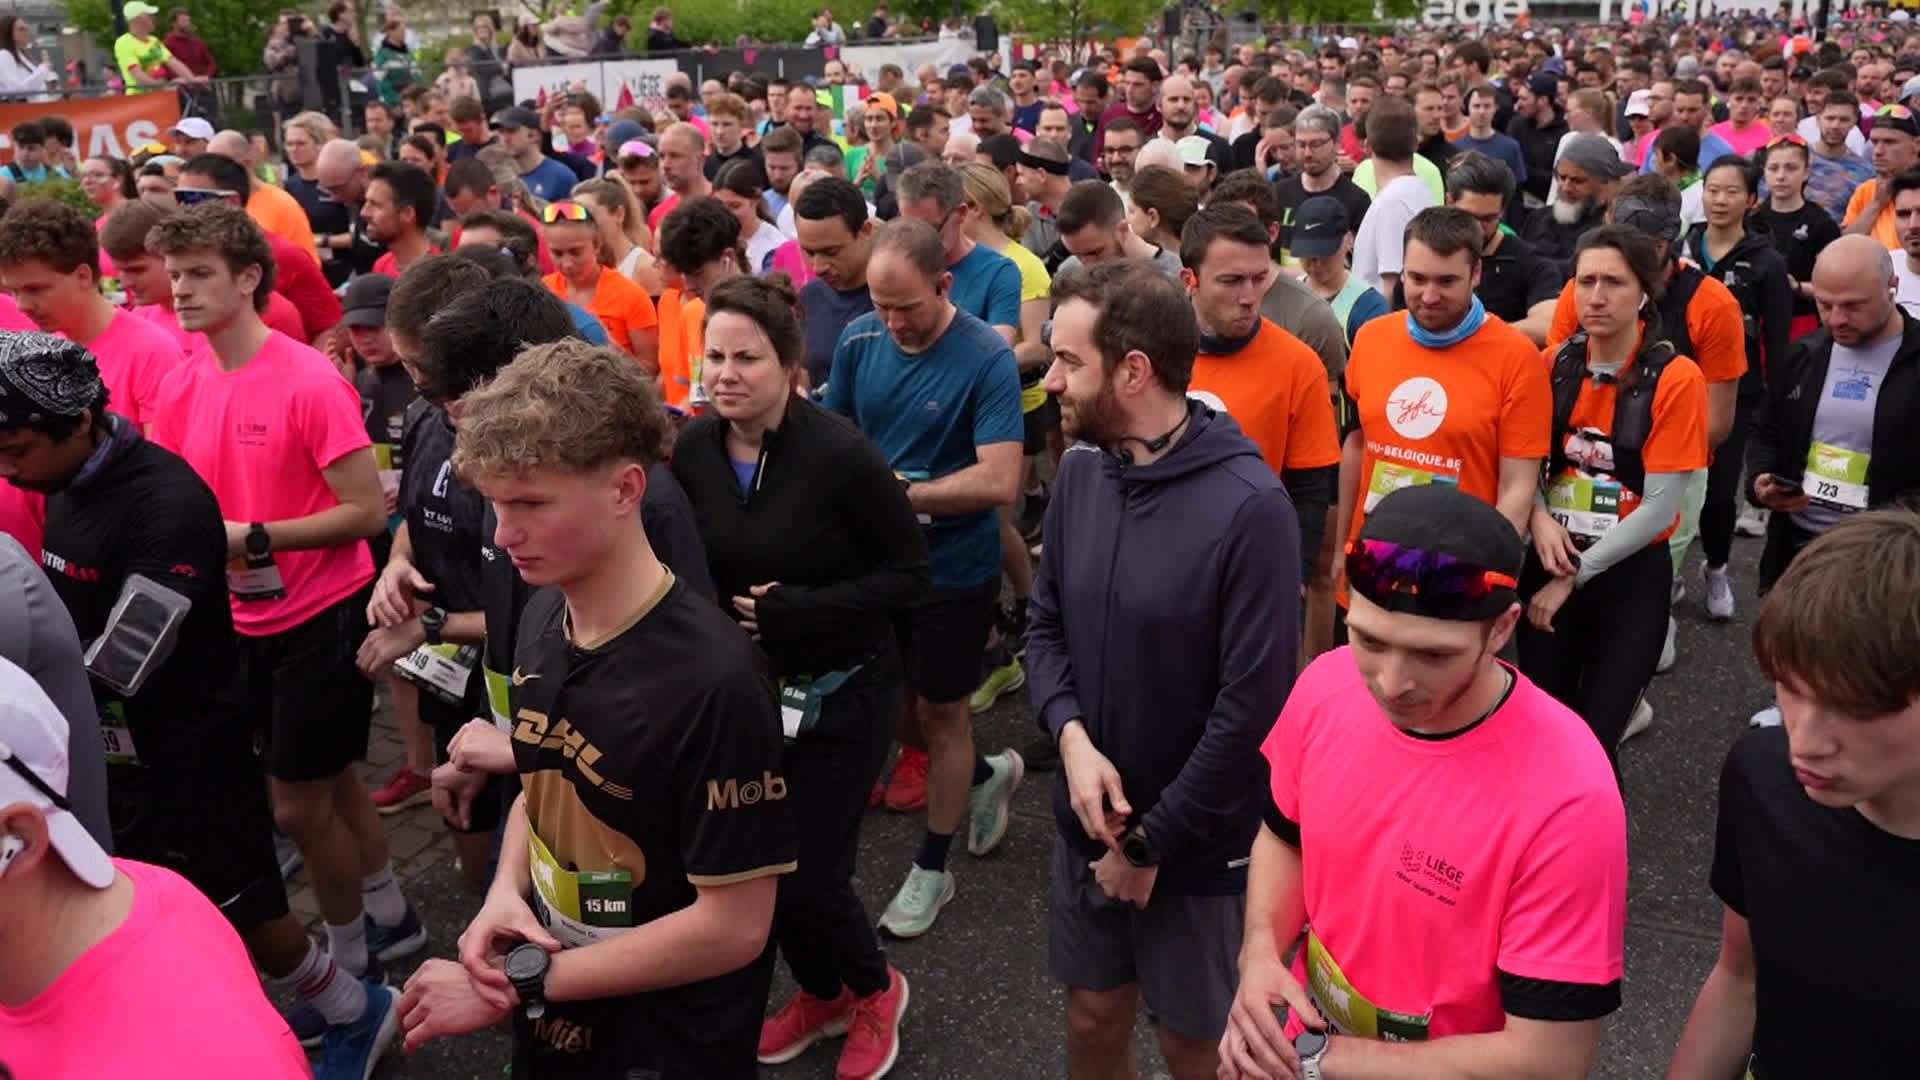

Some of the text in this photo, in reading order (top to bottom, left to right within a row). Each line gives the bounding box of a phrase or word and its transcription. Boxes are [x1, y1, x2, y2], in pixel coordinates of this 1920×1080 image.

[1818, 481, 1839, 498] 723
[512, 707, 605, 787] DHL
[1425, 855, 1465, 885] LIÈGE
[584, 898, 627, 913] 15 km
